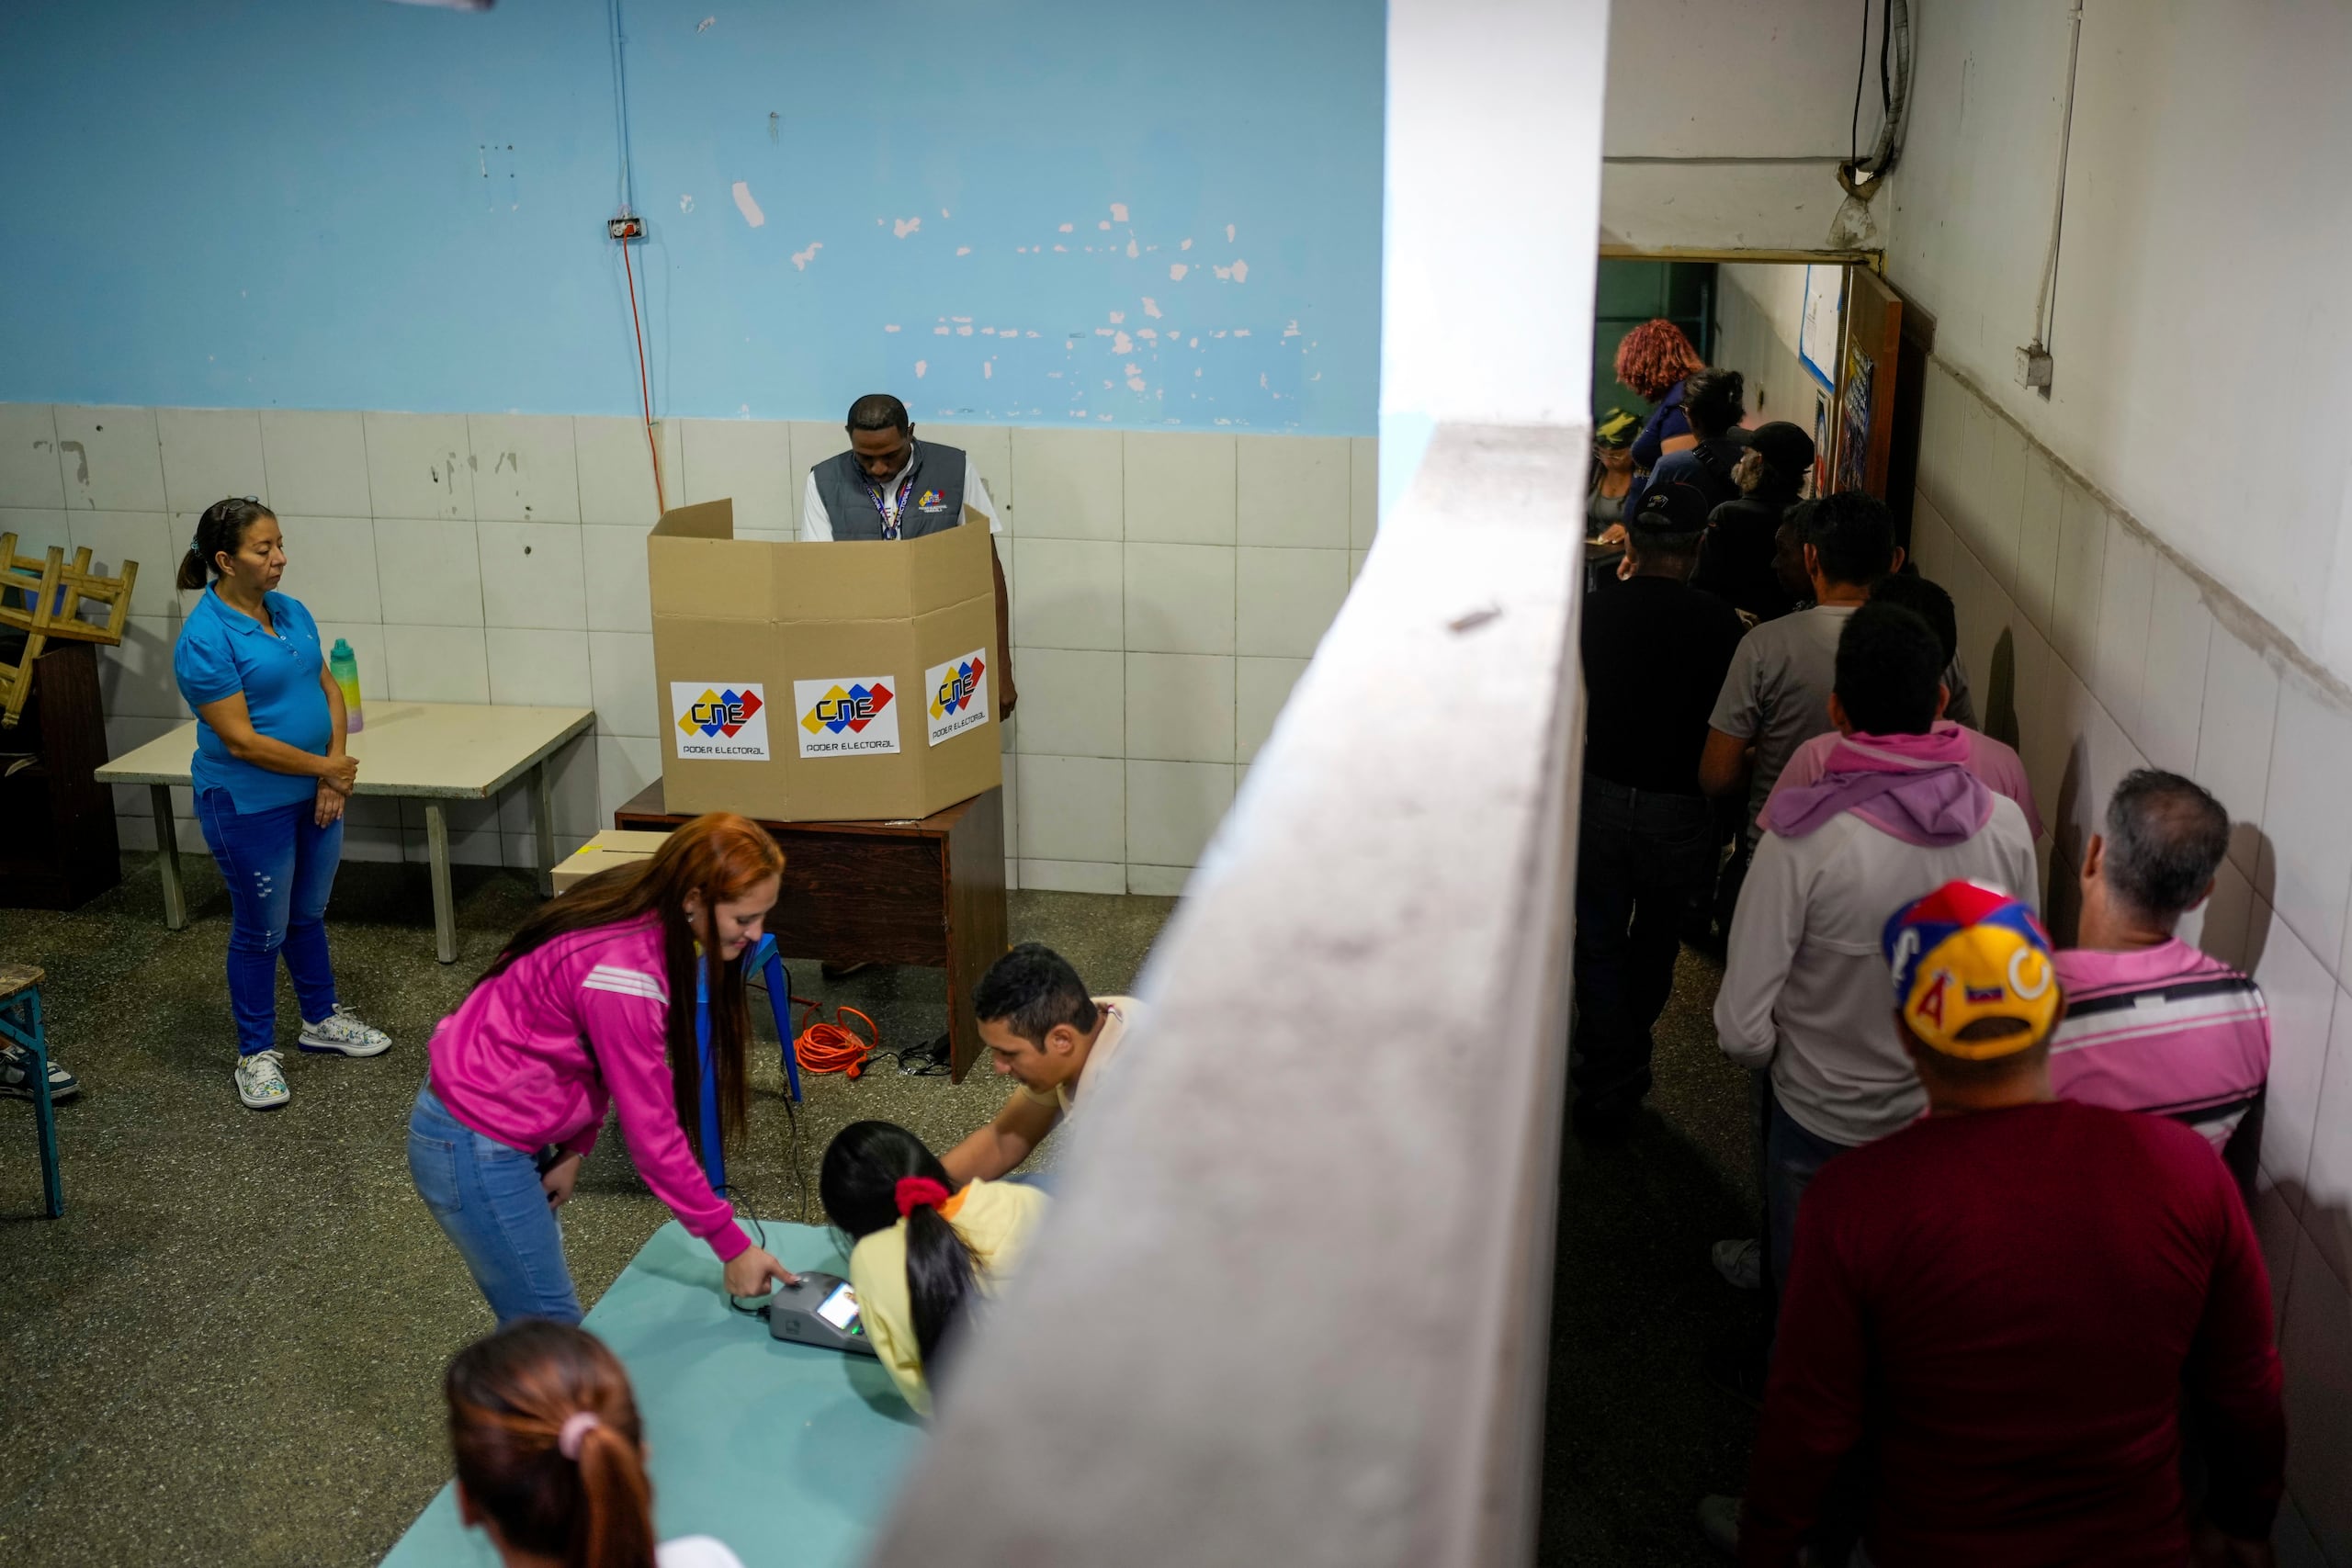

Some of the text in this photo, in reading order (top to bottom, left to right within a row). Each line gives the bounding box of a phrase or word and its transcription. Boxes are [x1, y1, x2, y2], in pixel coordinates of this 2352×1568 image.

[938, 673, 976, 705] CNE
[691, 704, 748, 724] CNE
[816, 698, 876, 721] CNE
[933, 725, 953, 739] PODER
[807, 743, 839, 751] PODER
